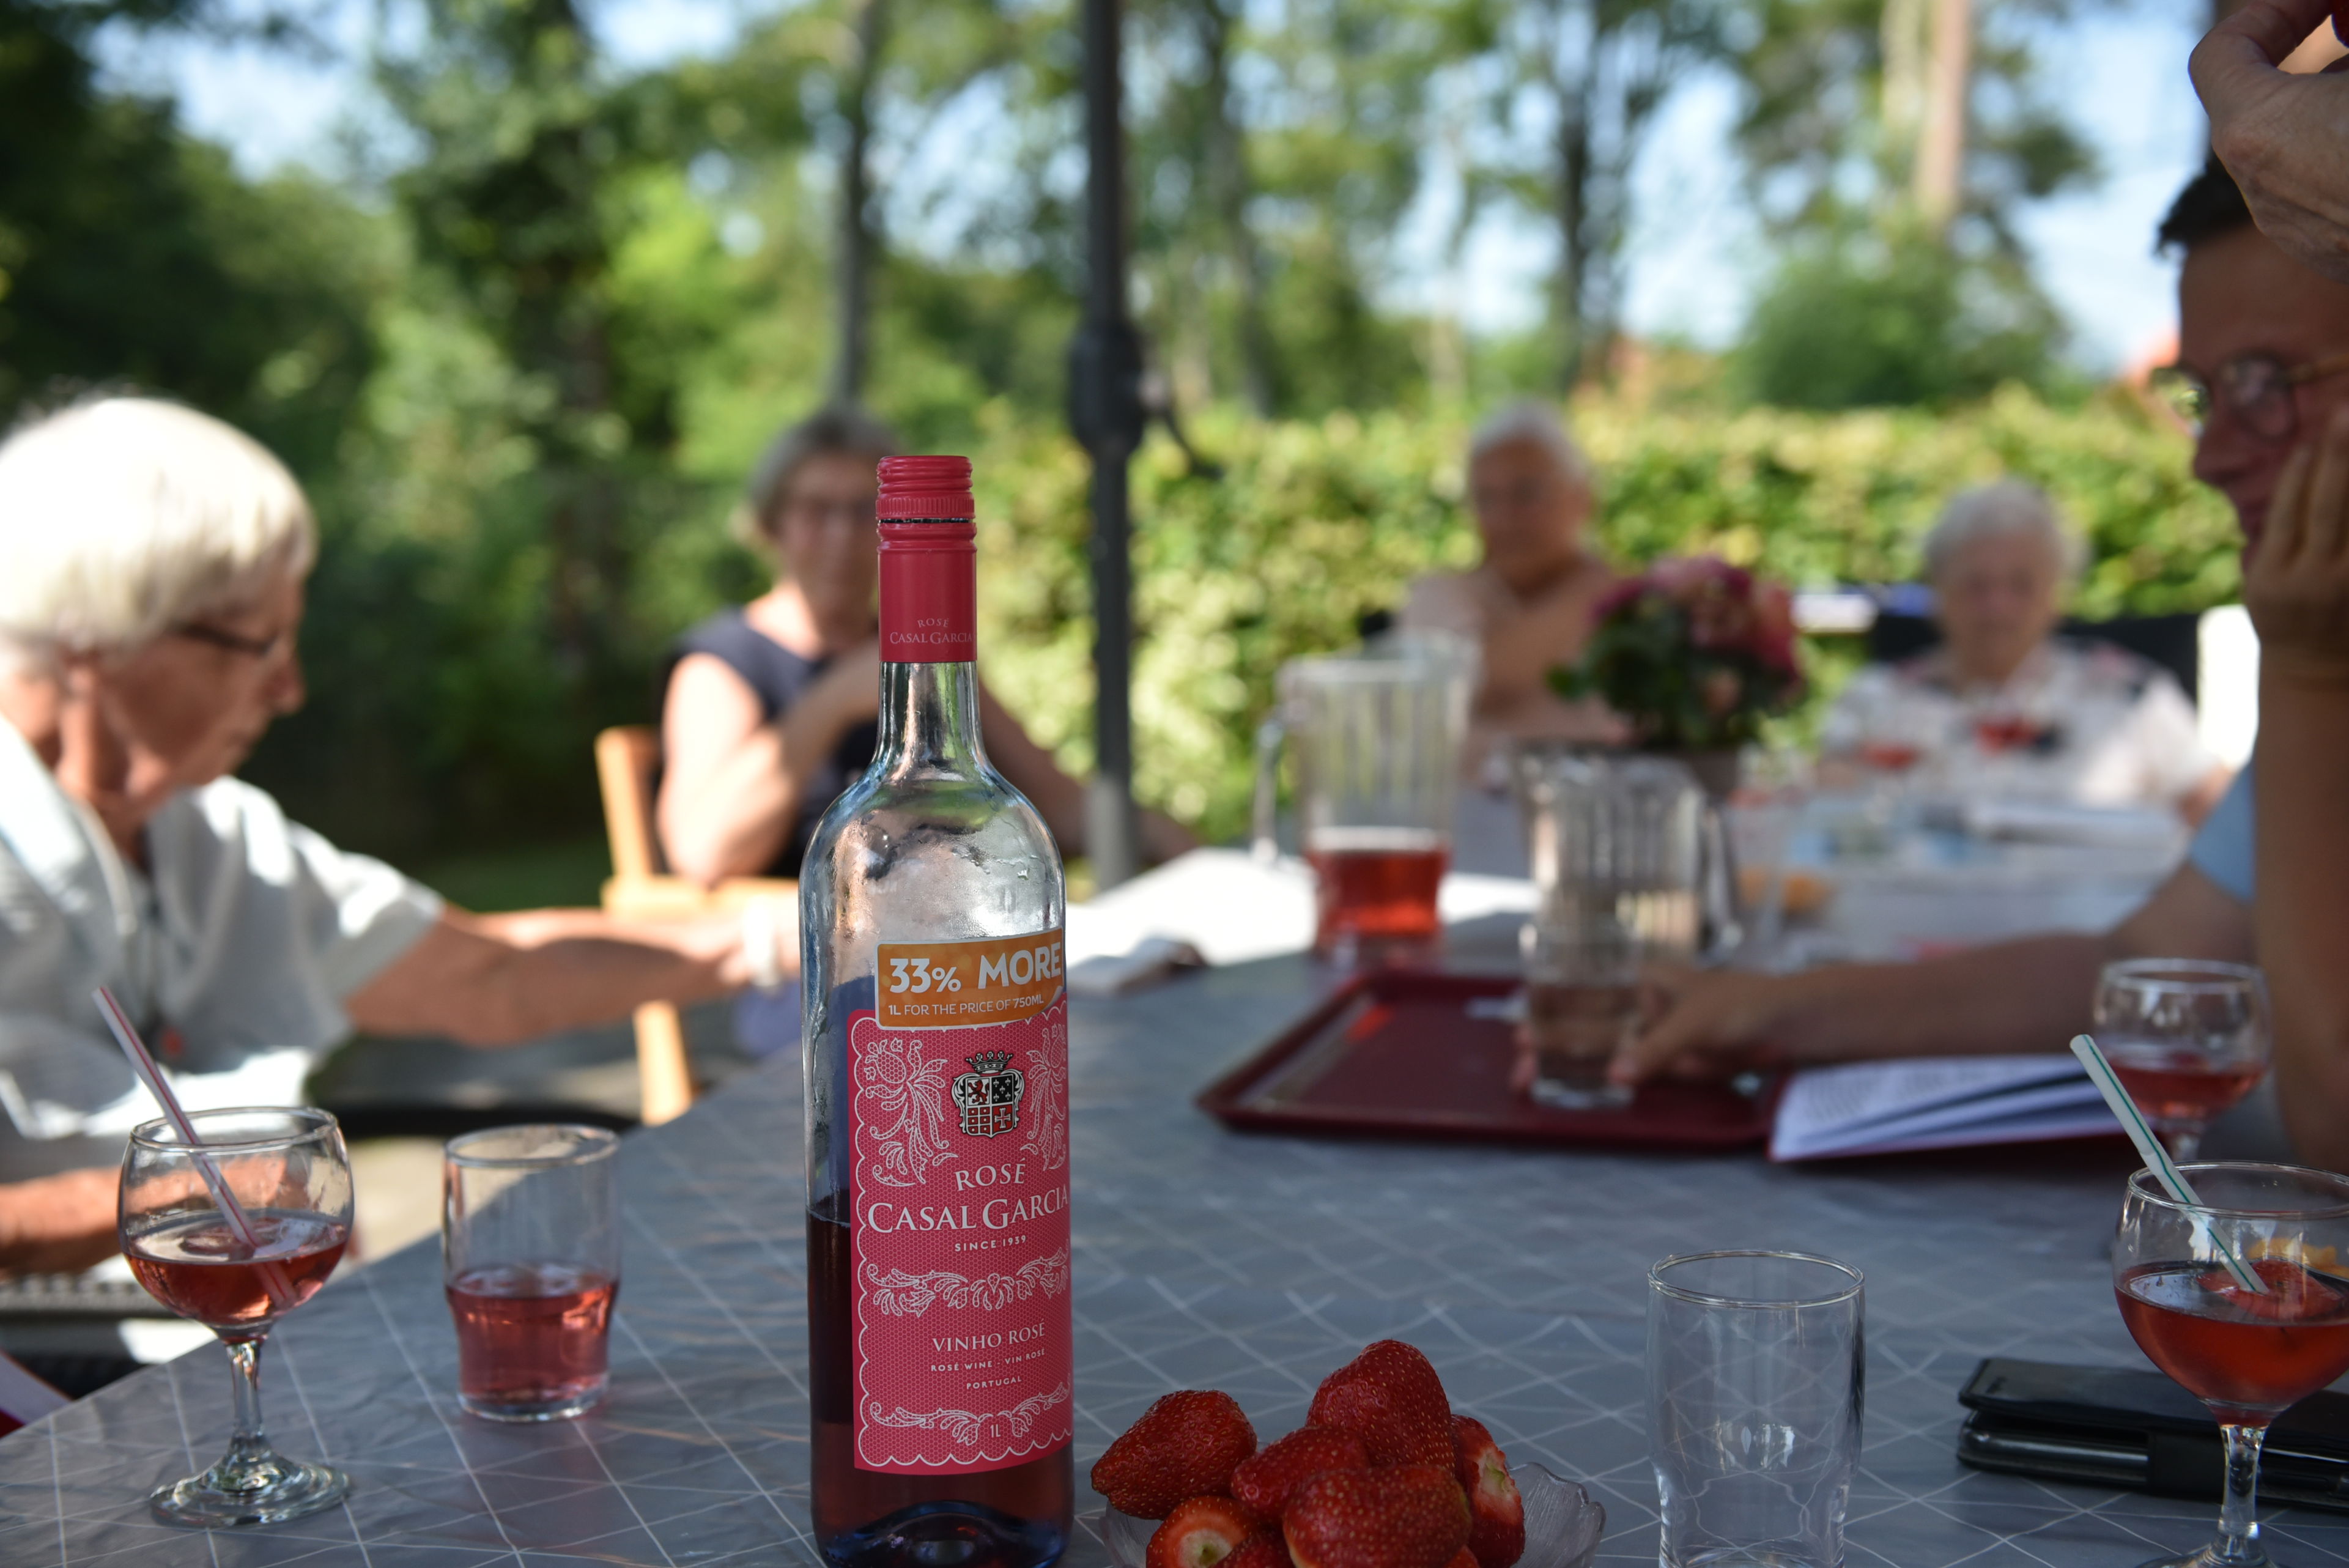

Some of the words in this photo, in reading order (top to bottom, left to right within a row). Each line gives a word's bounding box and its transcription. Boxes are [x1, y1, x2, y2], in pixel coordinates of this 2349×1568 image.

[890, 632, 927, 644] CASAL
[930, 632, 972, 644] GARCIA
[890, 958, 961, 993] 33%
[978, 942, 1061, 989] MORE
[889, 1005, 901, 1015] 1L
[904, 1005, 930, 1015] FOR
[932, 1004, 956, 1015] THE
[960, 1001, 993, 1014] PRICE
[996, 999, 1011, 1010] OF
[1013, 994, 1044, 1008] 750ML
[954, 1158, 1026, 1191] ROSÉ
[868, 1202, 977, 1233] CASAL
[982, 1183, 1068, 1230] GARCIA
[955, 1240, 996, 1252] SINCE
[1003, 1235, 1026, 1248] 1939
[932, 1333, 1002, 1352] VINHO
[1009, 1318, 1045, 1345] ROSÉ
[931, 1363, 960, 1372] ROSÉ
[964, 1361, 993, 1370] WINE
[1005, 1355, 1023, 1365] VIN
[1026, 1348, 1045, 1360] ROSÉ
[966, 1376, 1022, 1390] PORTUGAL
[990, 1424, 1001, 1438] 1L
